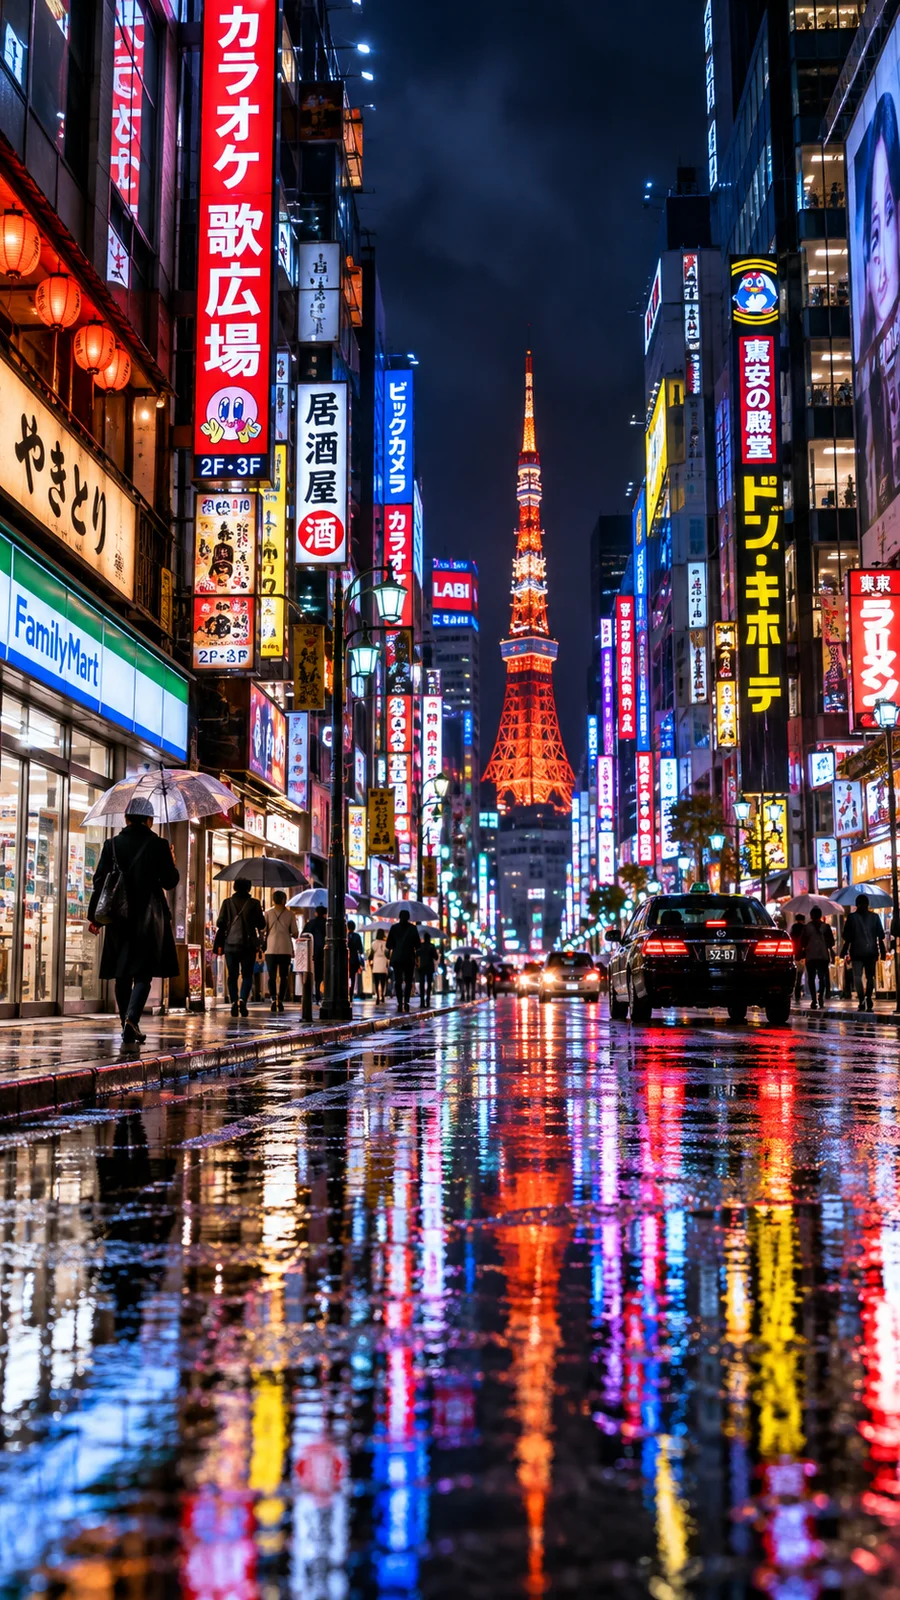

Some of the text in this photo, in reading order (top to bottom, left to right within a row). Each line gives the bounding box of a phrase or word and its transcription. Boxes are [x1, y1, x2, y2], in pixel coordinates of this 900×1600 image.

[14, 413, 107, 555] やきとり
[305, 391, 339, 505] 居酒屋
[388, 382, 408, 494] ビックカメラ
[305, 516, 337, 550] 酒
[14, 593, 99, 687] FamilyMart
[433, 582, 470, 599] LABI
